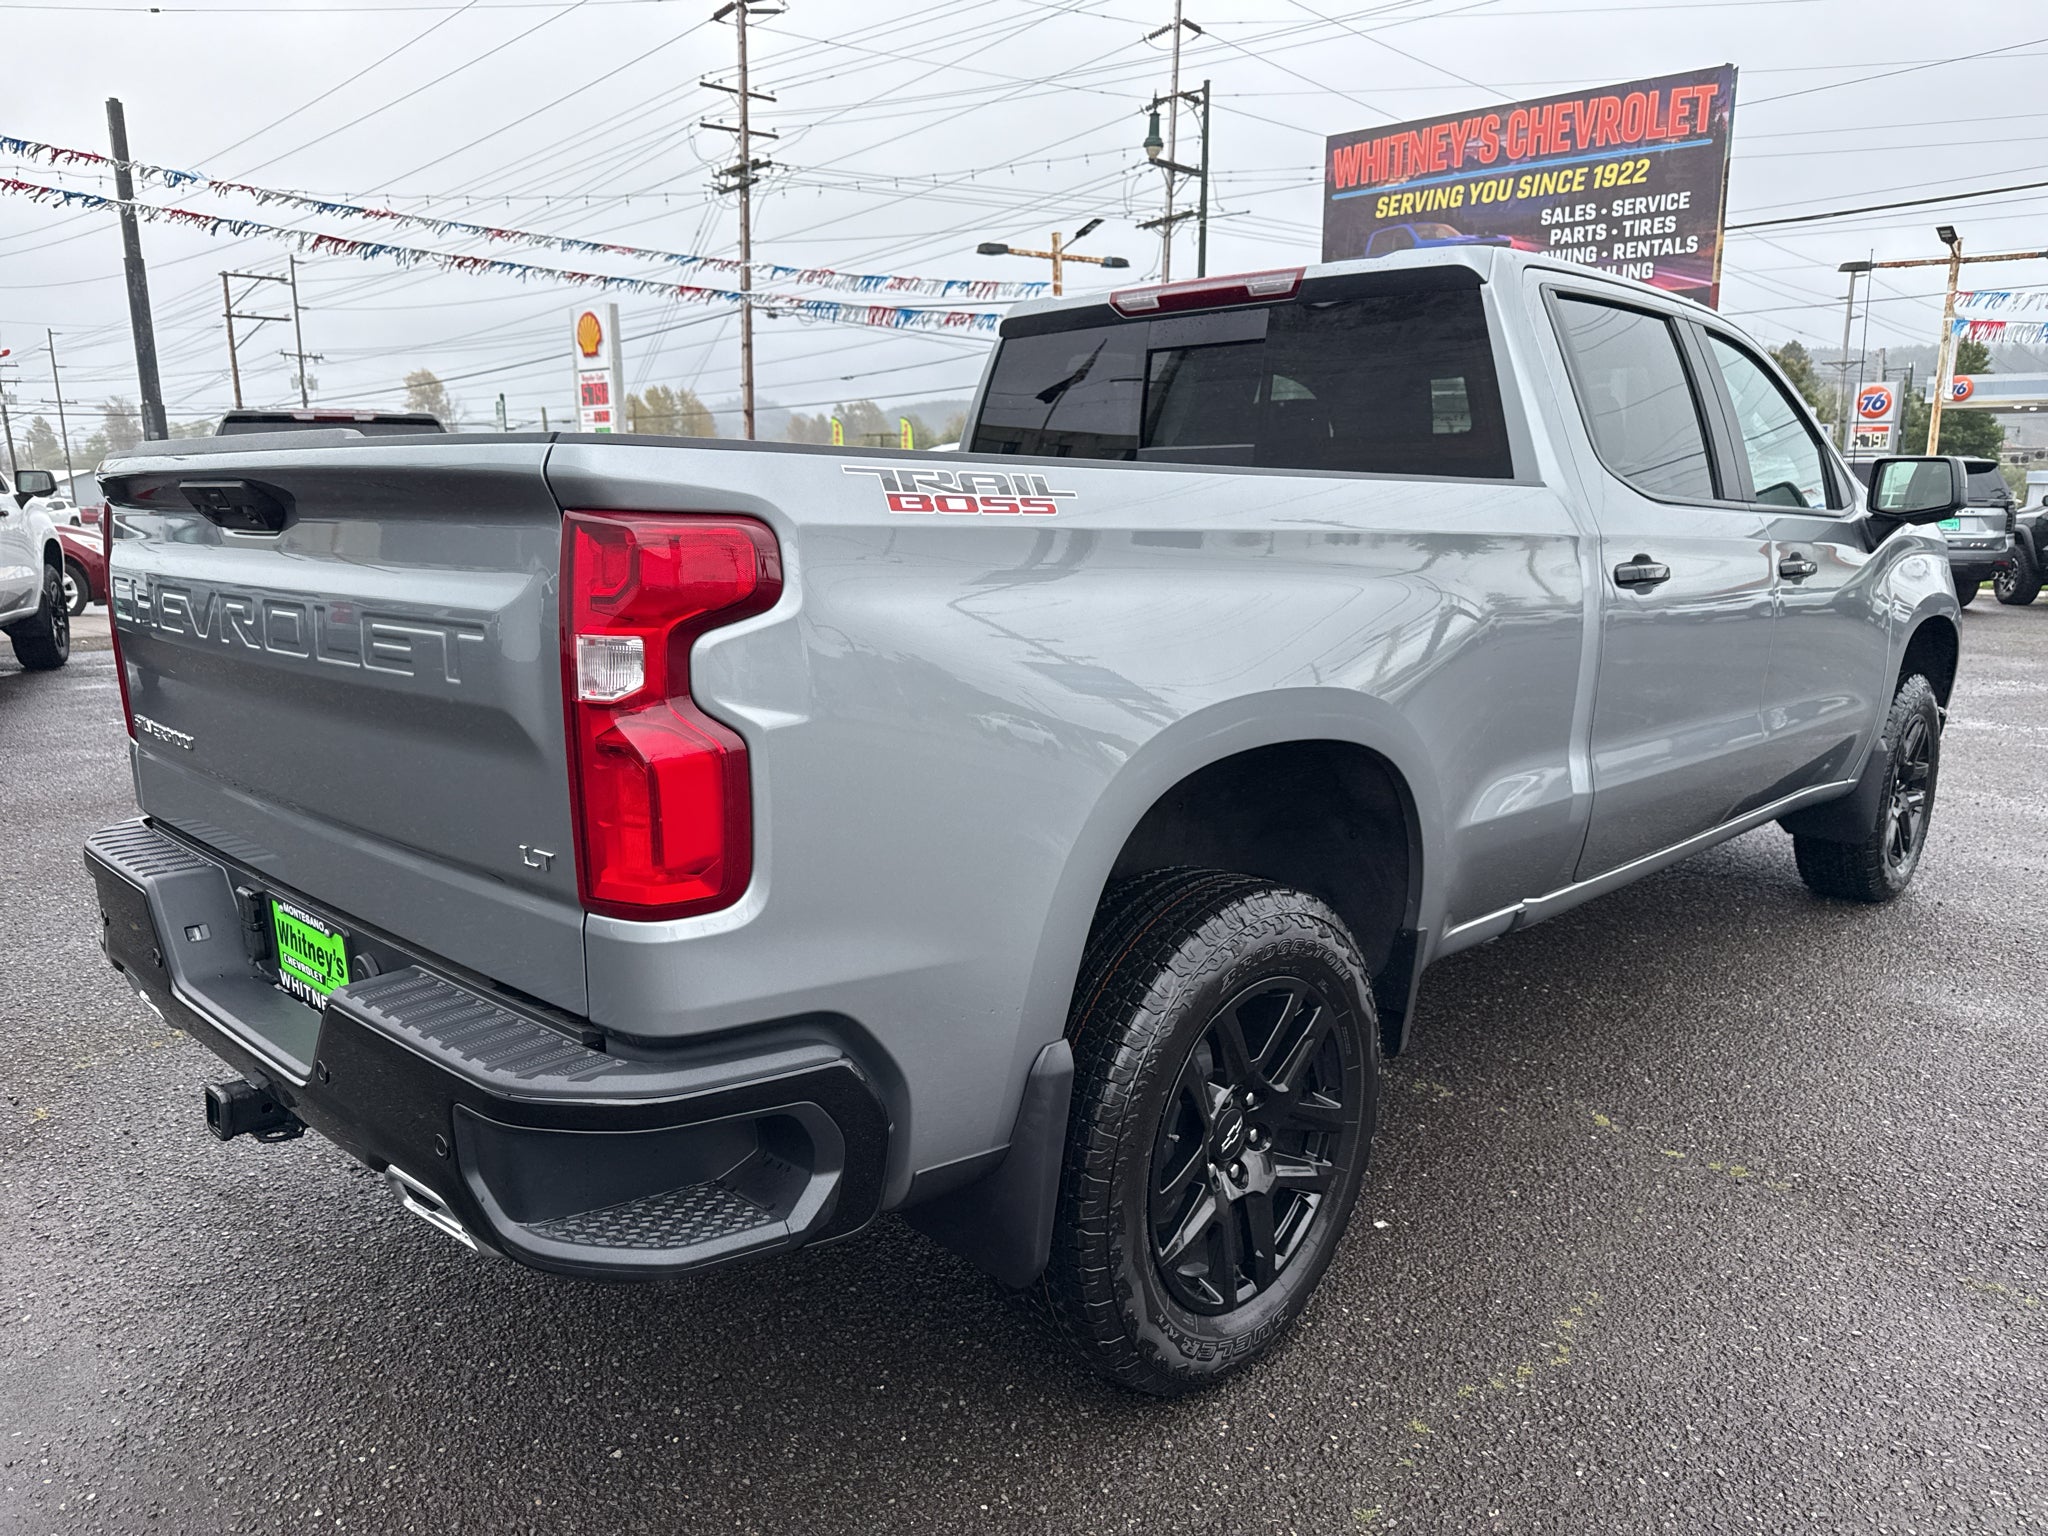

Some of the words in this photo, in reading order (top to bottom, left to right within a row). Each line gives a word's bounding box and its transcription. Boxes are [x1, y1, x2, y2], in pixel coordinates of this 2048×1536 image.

[1333, 114, 1500, 189] WHITNEY'S
[1506, 84, 1719, 160] CHEVROLET
[1375, 185, 1465, 219] SERVING
[1469, 177, 1514, 205] YOU
[1516, 167, 1588, 199] SINCE
[1593, 158, 1650, 190] 1922
[1540, 203, 1597, 225] SALES
[1611, 191, 1691, 217] SERVICE
[1550, 223, 1607, 245] PARTS
[1622, 215, 1677, 238] TIRES
[1612, 235, 1698, 260] RENTALS
[1861, 392, 1887, 412] 76
[841, 465, 1078, 499] TRAIL
[886, 493, 1057, 515] BOSS
[112, 575, 484, 684] CHEVROLET
[519, 844, 555, 871] LT
[282, 902, 325, 932] MONTESANO
[277, 918, 345, 979] Whitney's
[283, 954, 323, 984] CHEVROLET
